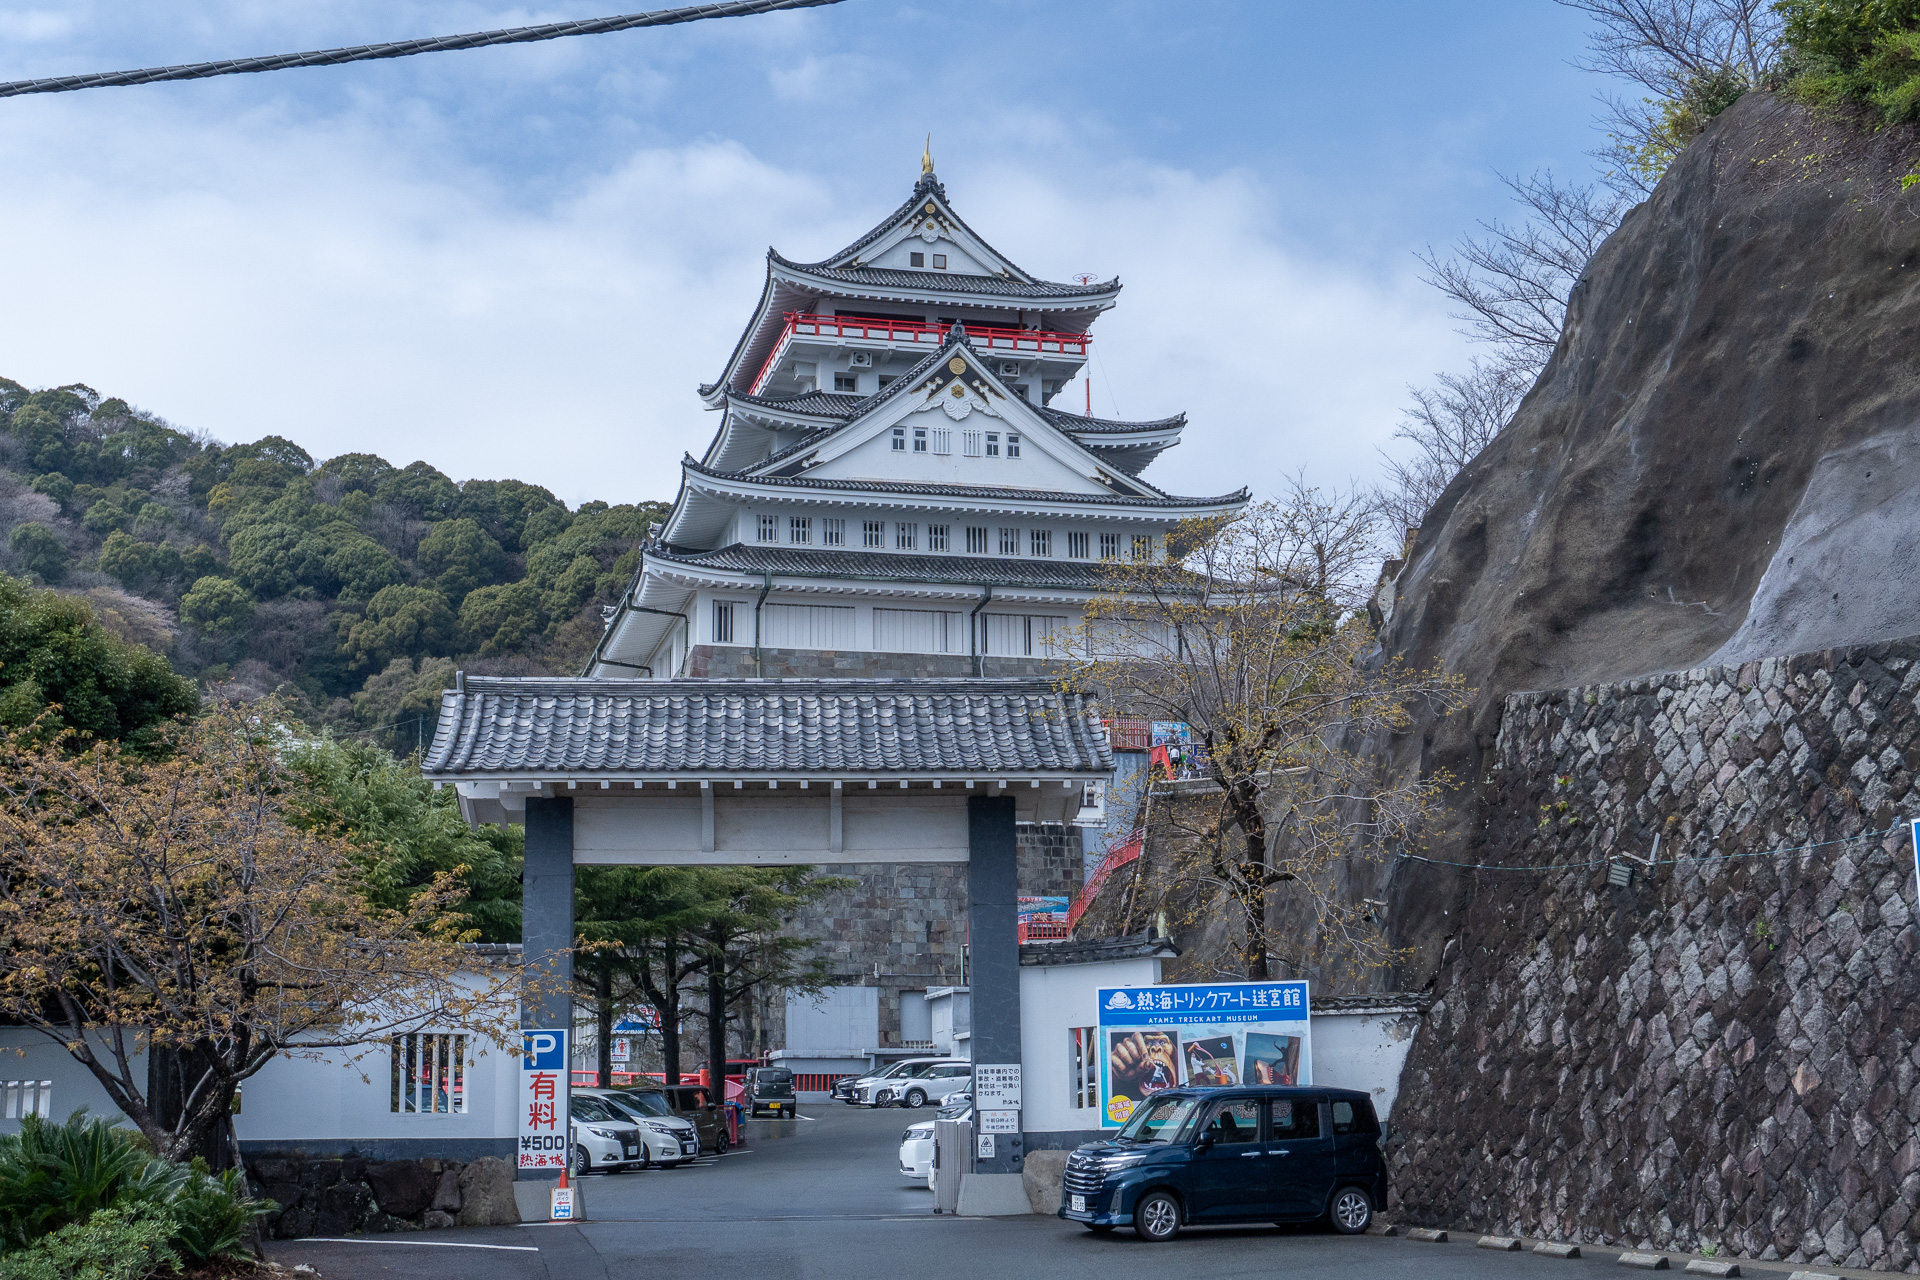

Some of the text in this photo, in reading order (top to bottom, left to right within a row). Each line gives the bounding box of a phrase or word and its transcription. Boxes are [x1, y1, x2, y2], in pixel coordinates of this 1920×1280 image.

[1136, 988, 1301, 1011] 熱海トリックアート迷宮館
[531, 1034, 557, 1067] P
[529, 1071, 558, 1131] 有料
[1108, 1099, 1131, 1113] 熱海城
[1114, 1110, 1130, 1121] 別館
[521, 1136, 565, 1151] ¥500
[519, 1153, 566, 1168] 熱海城
